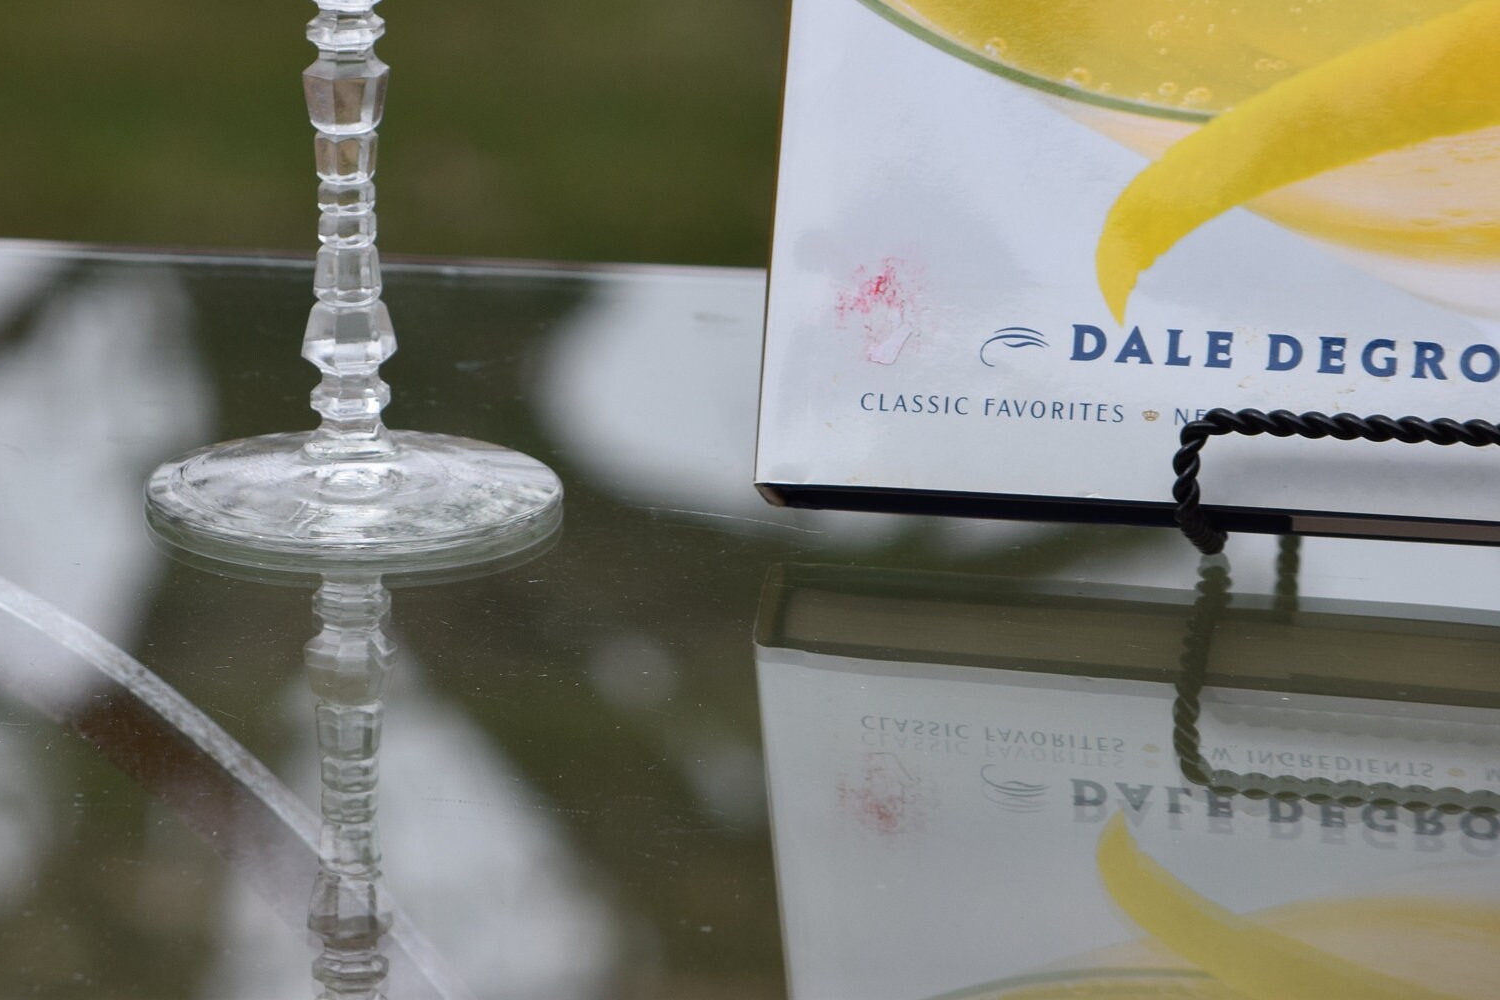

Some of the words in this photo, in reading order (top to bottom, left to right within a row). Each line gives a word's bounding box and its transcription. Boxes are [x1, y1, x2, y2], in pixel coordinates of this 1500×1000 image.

[1069, 323, 1235, 369] DALE
[1264, 333, 1500, 383] DEGRO
[860, 392, 969, 416] CLASSIC
[983, 397, 1125, 423] FAVORITES
